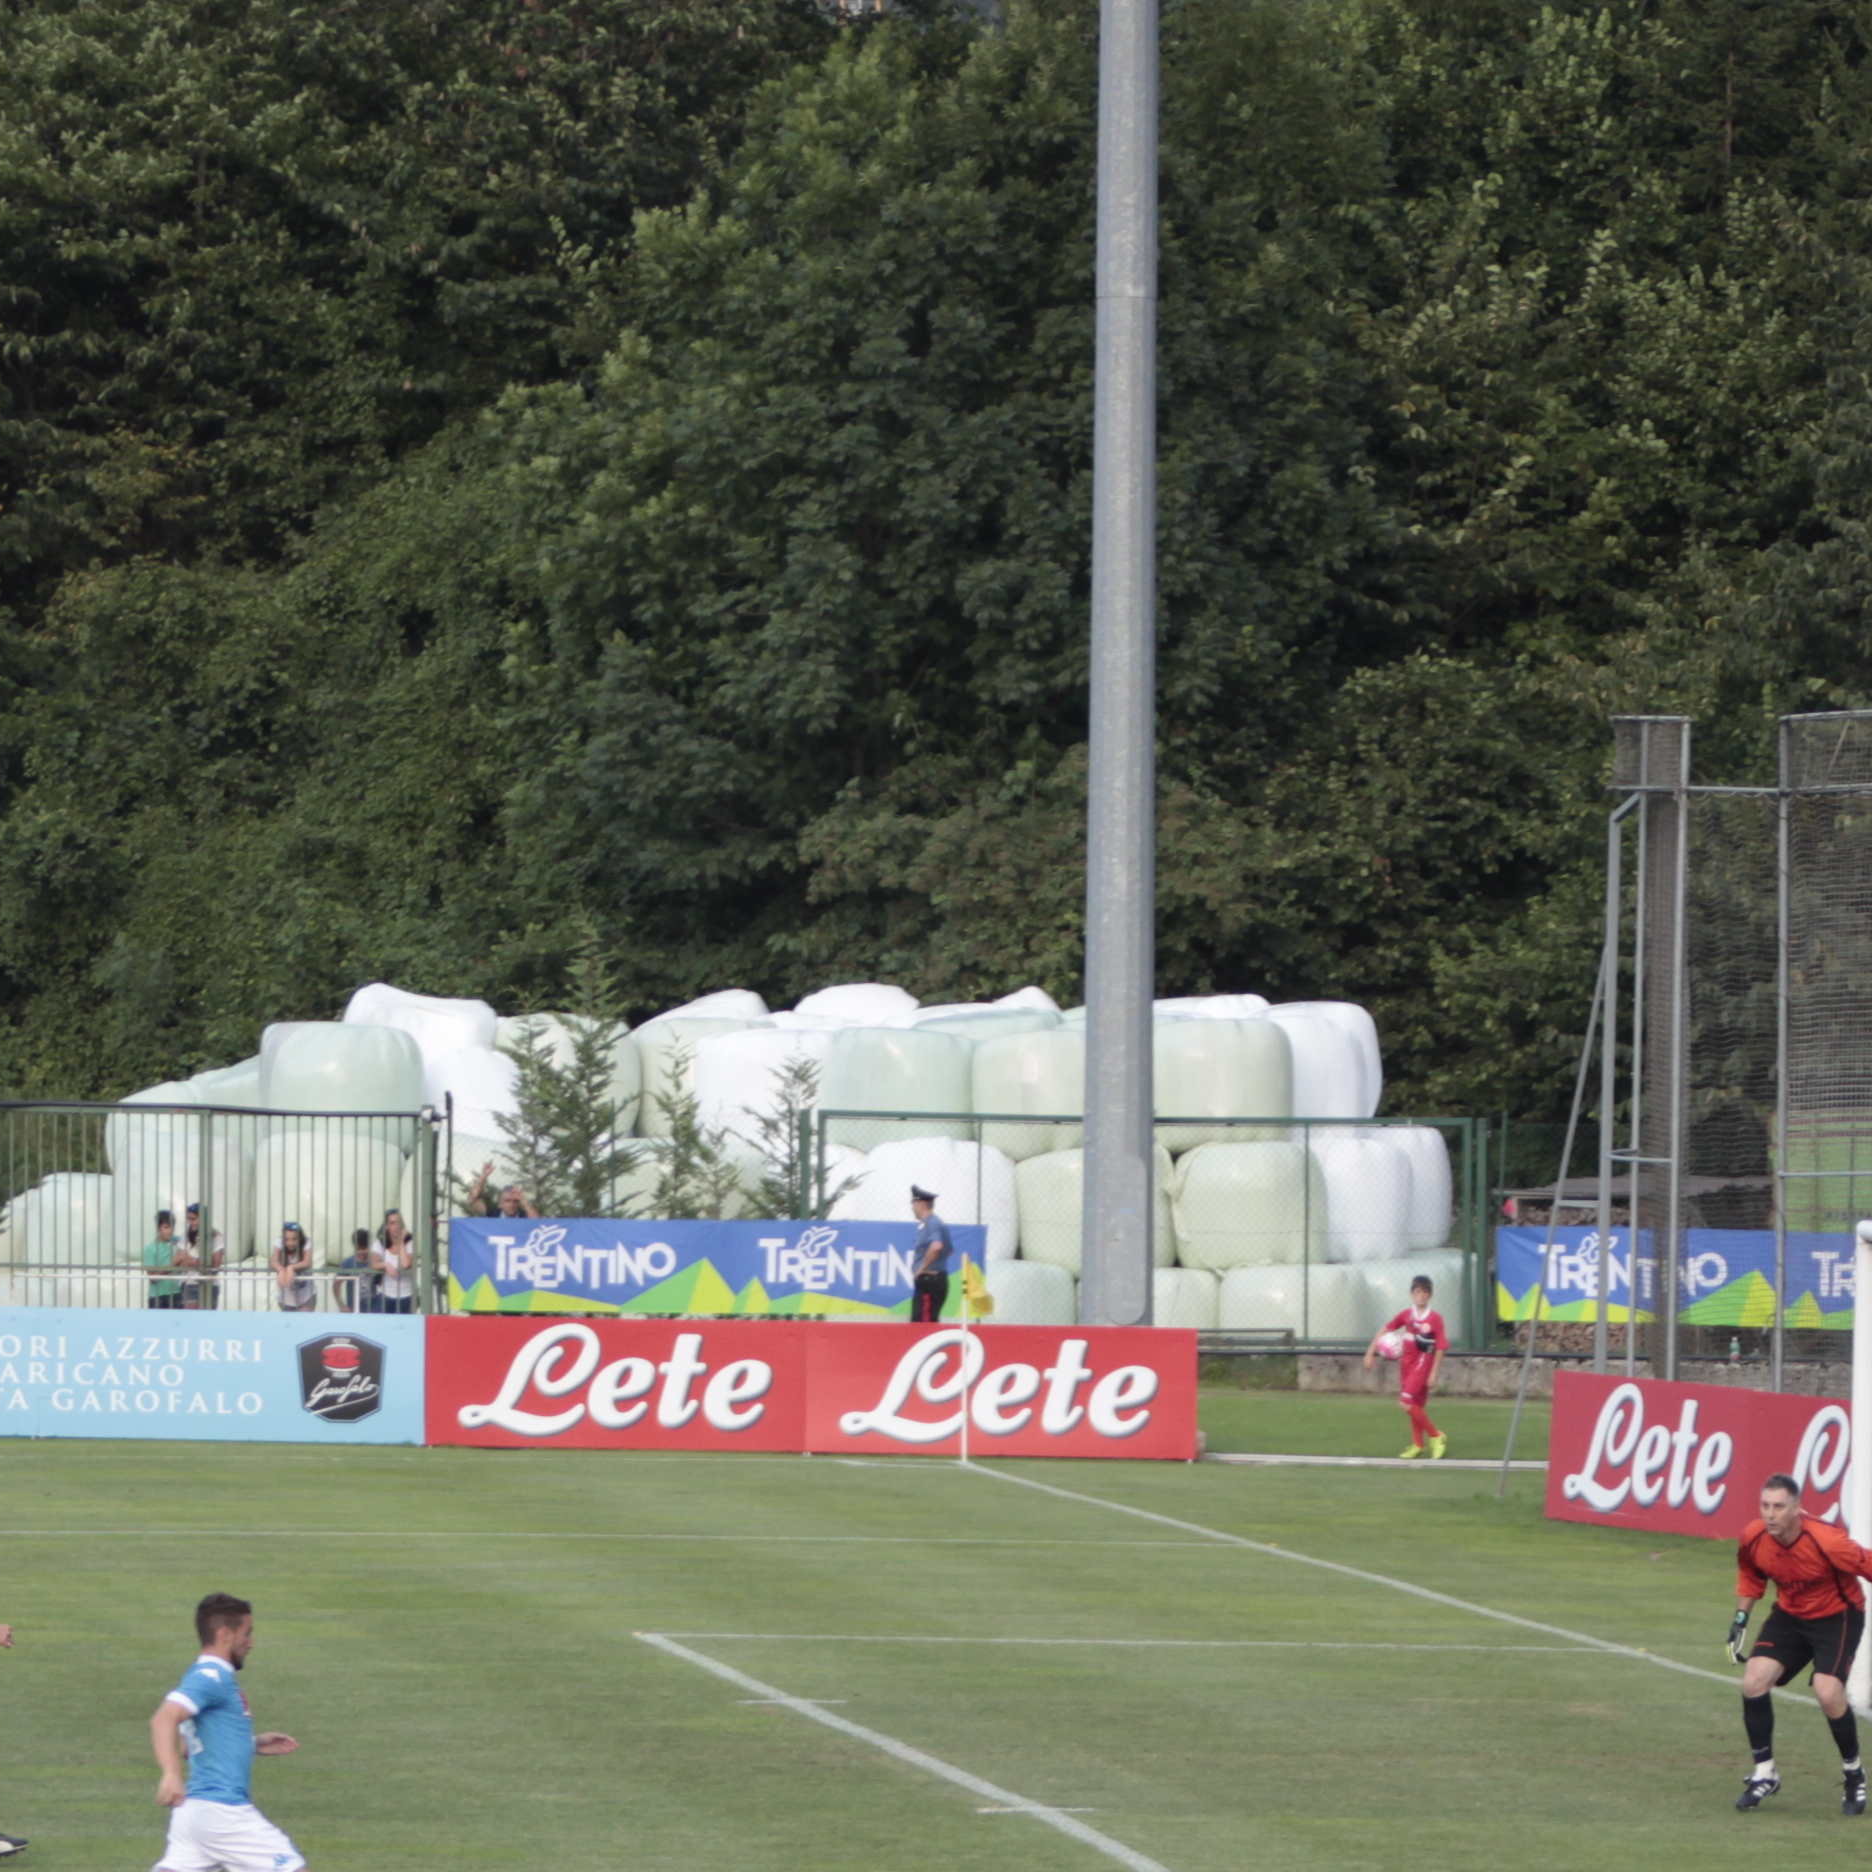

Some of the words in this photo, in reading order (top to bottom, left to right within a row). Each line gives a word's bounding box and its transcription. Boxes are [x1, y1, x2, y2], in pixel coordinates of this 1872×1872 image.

[486, 1235, 676, 1290] TRENTINO
[758, 1237, 915, 1292] TRENTIN
[88, 1335, 263, 1363] AZZURRI
[50, 1387, 264, 1416] GAROFALO
[458, 1322, 774, 1437] Lete
[839, 1328, 1159, 1444] Lete
[1562, 1382, 1733, 1515] Lete
